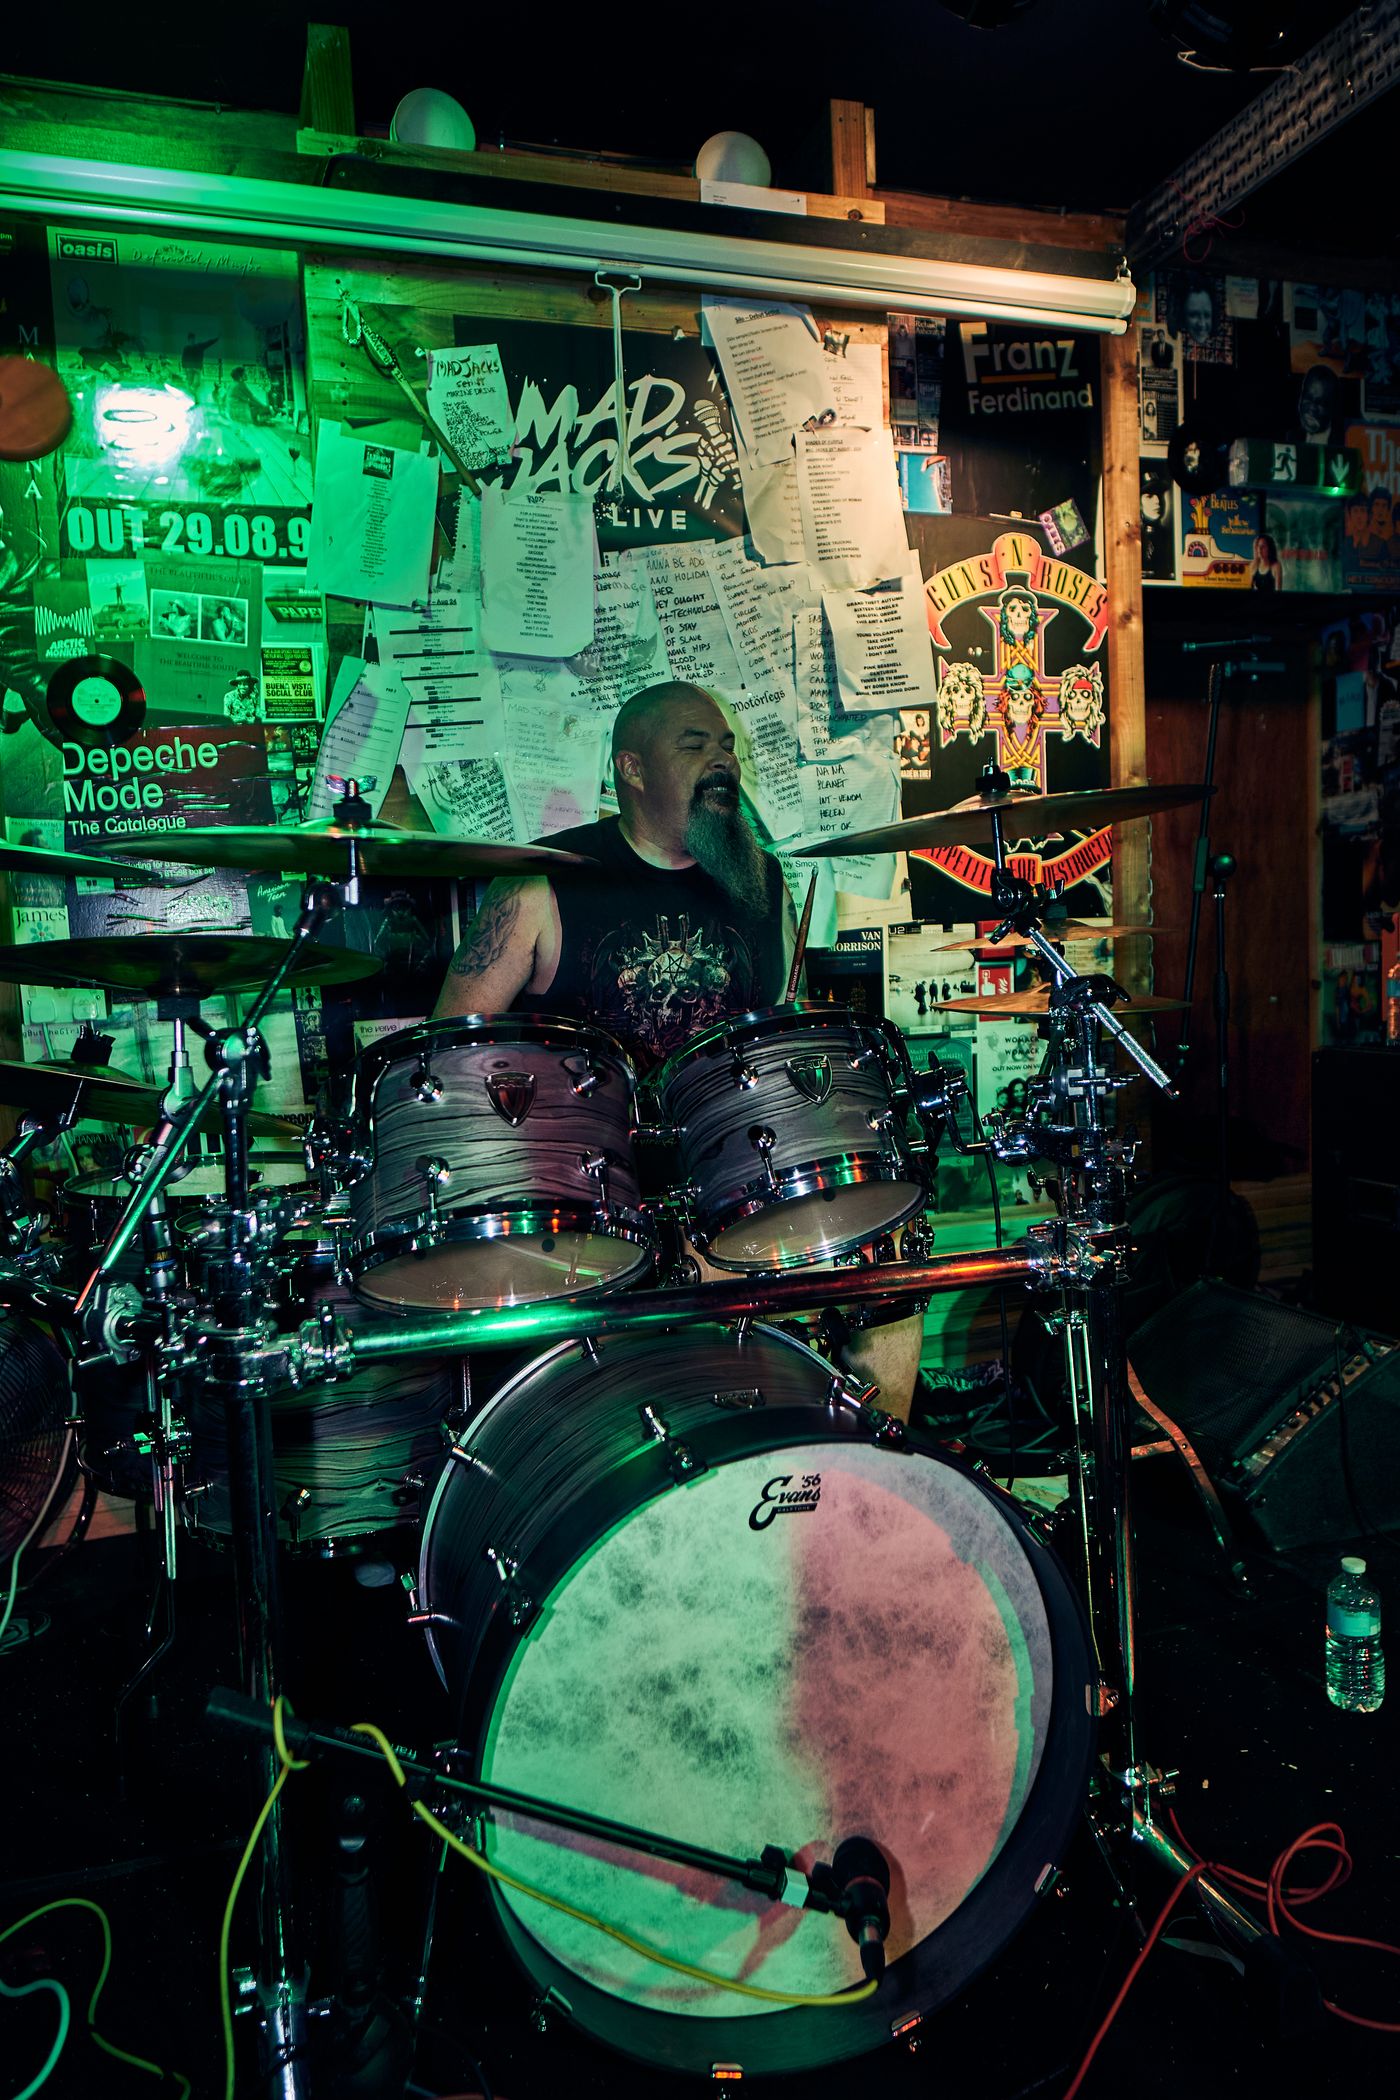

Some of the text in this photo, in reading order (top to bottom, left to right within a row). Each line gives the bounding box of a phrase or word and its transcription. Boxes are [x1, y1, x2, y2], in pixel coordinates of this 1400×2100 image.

[62, 242, 112, 258] oasis
[959, 321, 1079, 384] Franz
[968, 383, 1094, 414] Ferdinand
[515, 376, 687, 448] MAD
[479, 434, 703, 504] JACKS
[611, 507, 687, 530] LIVE
[67, 507, 149, 551] OUT
[160, 511, 312, 558] 29.08.9
[647, 558, 670, 571] ANNA
[925, 538, 1108, 618] GUNS N ROSES
[673, 594, 705, 604] OUGHT
[664, 622, 697, 635] TO STAY
[49, 638, 86, 650] ARCTIC
[867, 643, 894, 651] SATURDAY
[45, 647, 88, 659] MONKEYS
[890, 680, 906, 688] KNOW
[266, 689, 292, 697] SOCIAL
[63, 737, 219, 781] Depeche
[817, 779, 848, 790] PLANET
[63, 777, 164, 814] Mode
[820, 809, 846, 819] HELEN
[68, 816, 187, 836] The Catalogue
[820, 824, 837, 832] NOT
[926, 845, 993, 889] APPETIT
[1009, 858, 1037, 882] FOR
[257, 881, 291, 898] American
[267, 889, 287, 900] Teen
[15, 907, 67, 928] James
[861, 931, 881, 940] VAN
[889, 926, 905, 935] U2
[1005, 1048, 1040, 1056] WOMACK
[748, 1475, 821, 1531] Evans
